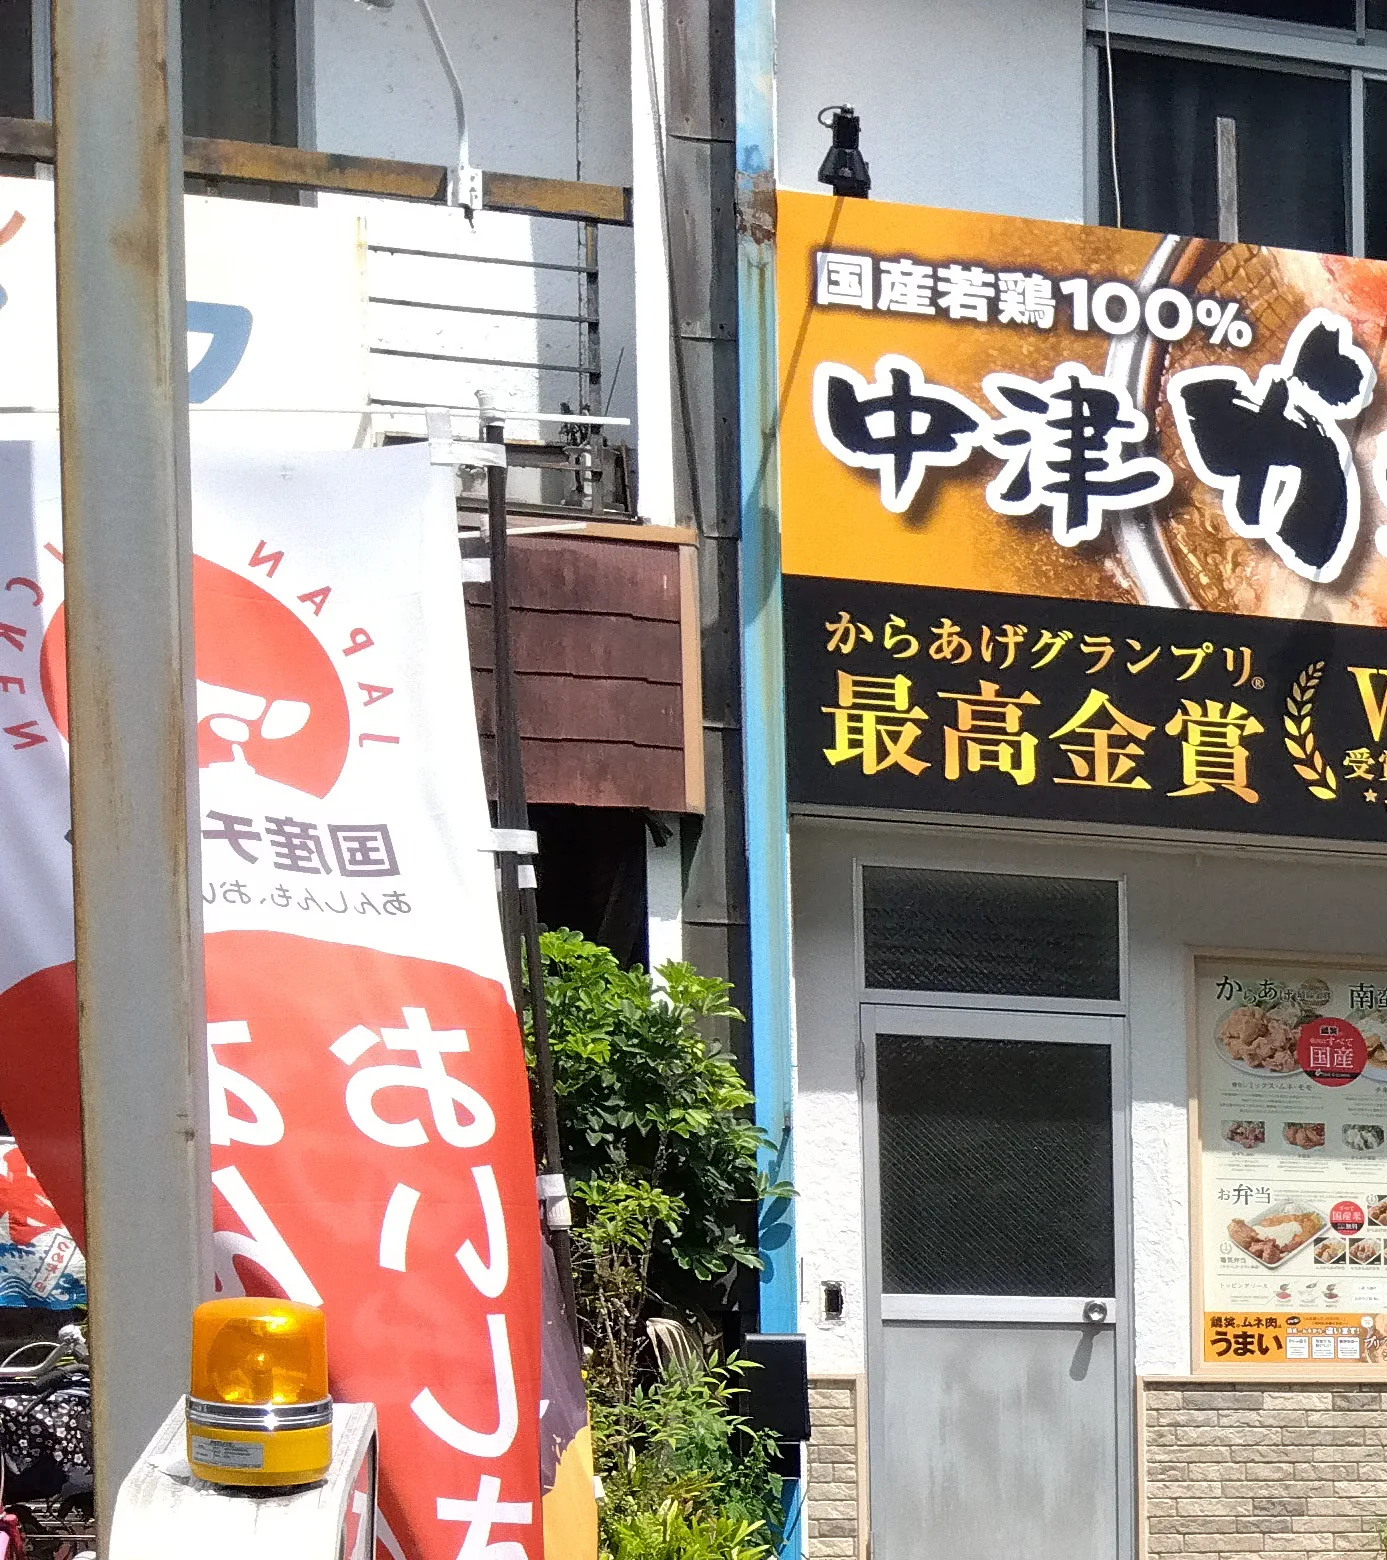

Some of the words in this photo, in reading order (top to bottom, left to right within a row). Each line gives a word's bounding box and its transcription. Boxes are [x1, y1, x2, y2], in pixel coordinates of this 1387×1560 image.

[817, 252, 1253, 350] 国産若鶏100%
[822, 669, 1263, 804] 最高金賞
[1310, 1046, 1354, 1069] 国産
[1218, 1184, 1270, 1205] お弁当
[1210, 1331, 1283, 1357] うまい
